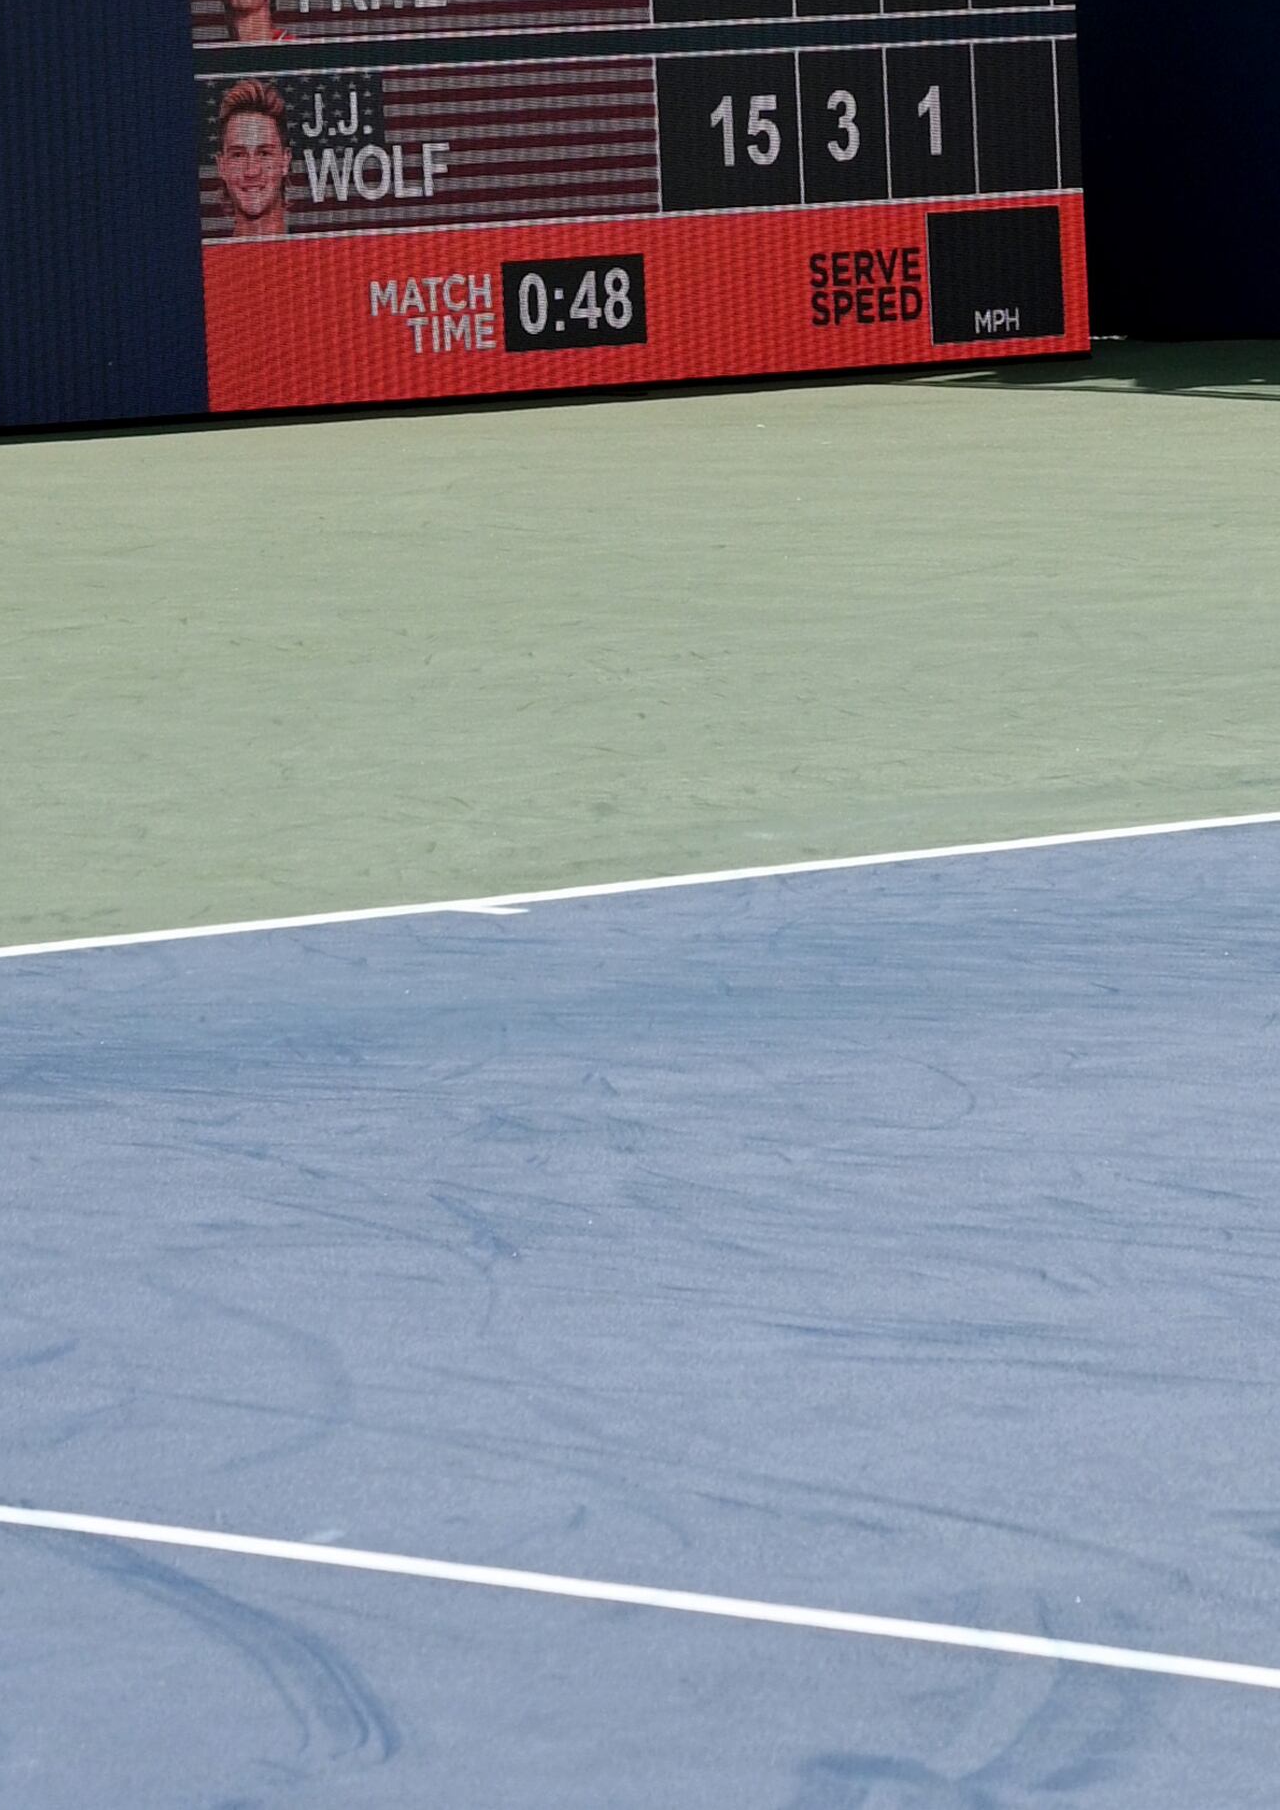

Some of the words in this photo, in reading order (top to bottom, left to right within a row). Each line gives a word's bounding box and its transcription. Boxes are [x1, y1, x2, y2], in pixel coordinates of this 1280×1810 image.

[302, 90, 373, 137] J.J.
[711, 93, 782, 167] 15
[826, 90, 861, 163] 3
[918, 86, 944, 156] 1
[304, 144, 450, 203] WOLF
[809, 248, 920, 289] SERVE
[369, 274, 493, 317] MATCH
[516, 267, 634, 335] 0:48
[811, 285, 921, 327] SPEED
[408, 314, 496, 354] TIME
[975, 307, 1021, 334] MPH
